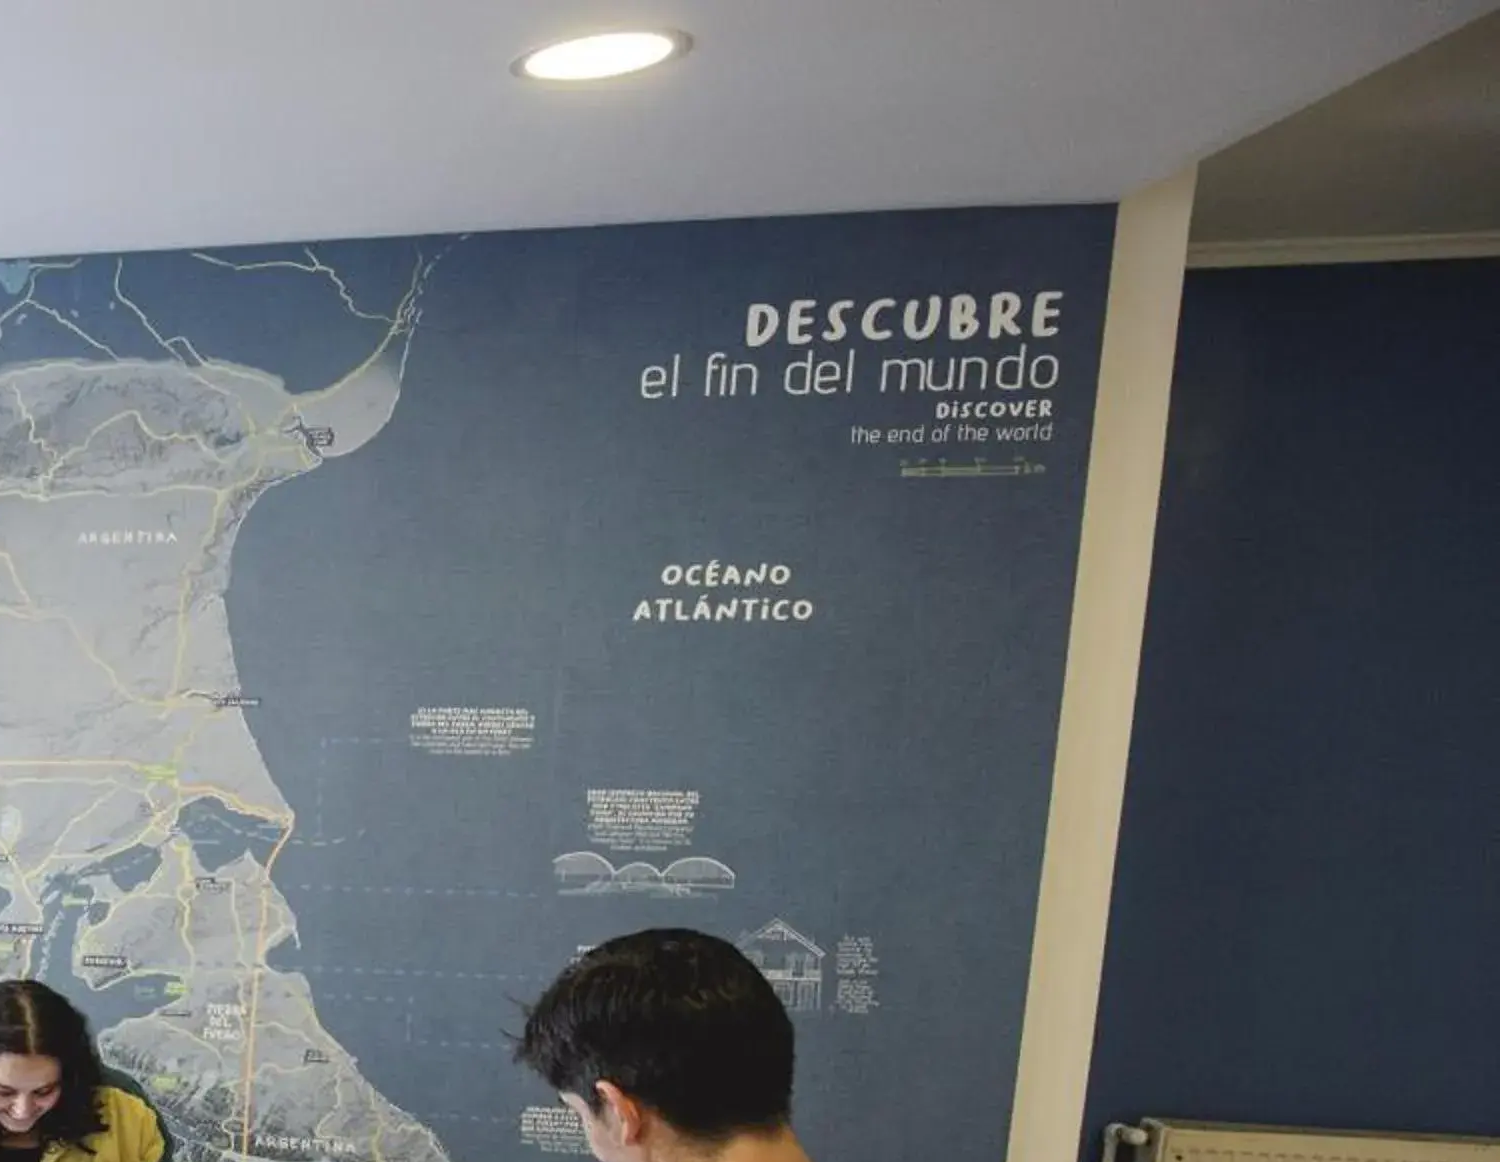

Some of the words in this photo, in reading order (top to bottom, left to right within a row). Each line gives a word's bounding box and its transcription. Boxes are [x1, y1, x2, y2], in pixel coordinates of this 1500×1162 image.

[746, 291, 1063, 347] DESCUBRE
[641, 354, 680, 399] el
[705, 352, 758, 397] fin
[784, 349, 855, 396] del
[880, 343, 1059, 393] mundo
[851, 426, 881, 444] the
[887, 425, 925, 443] end
[931, 424, 951, 442] of
[958, 424, 989, 441] the
[996, 422, 1053, 442] world
[661, 560, 791, 587] OCÉANO
[255, 1134, 358, 1156] ARGENTINA
